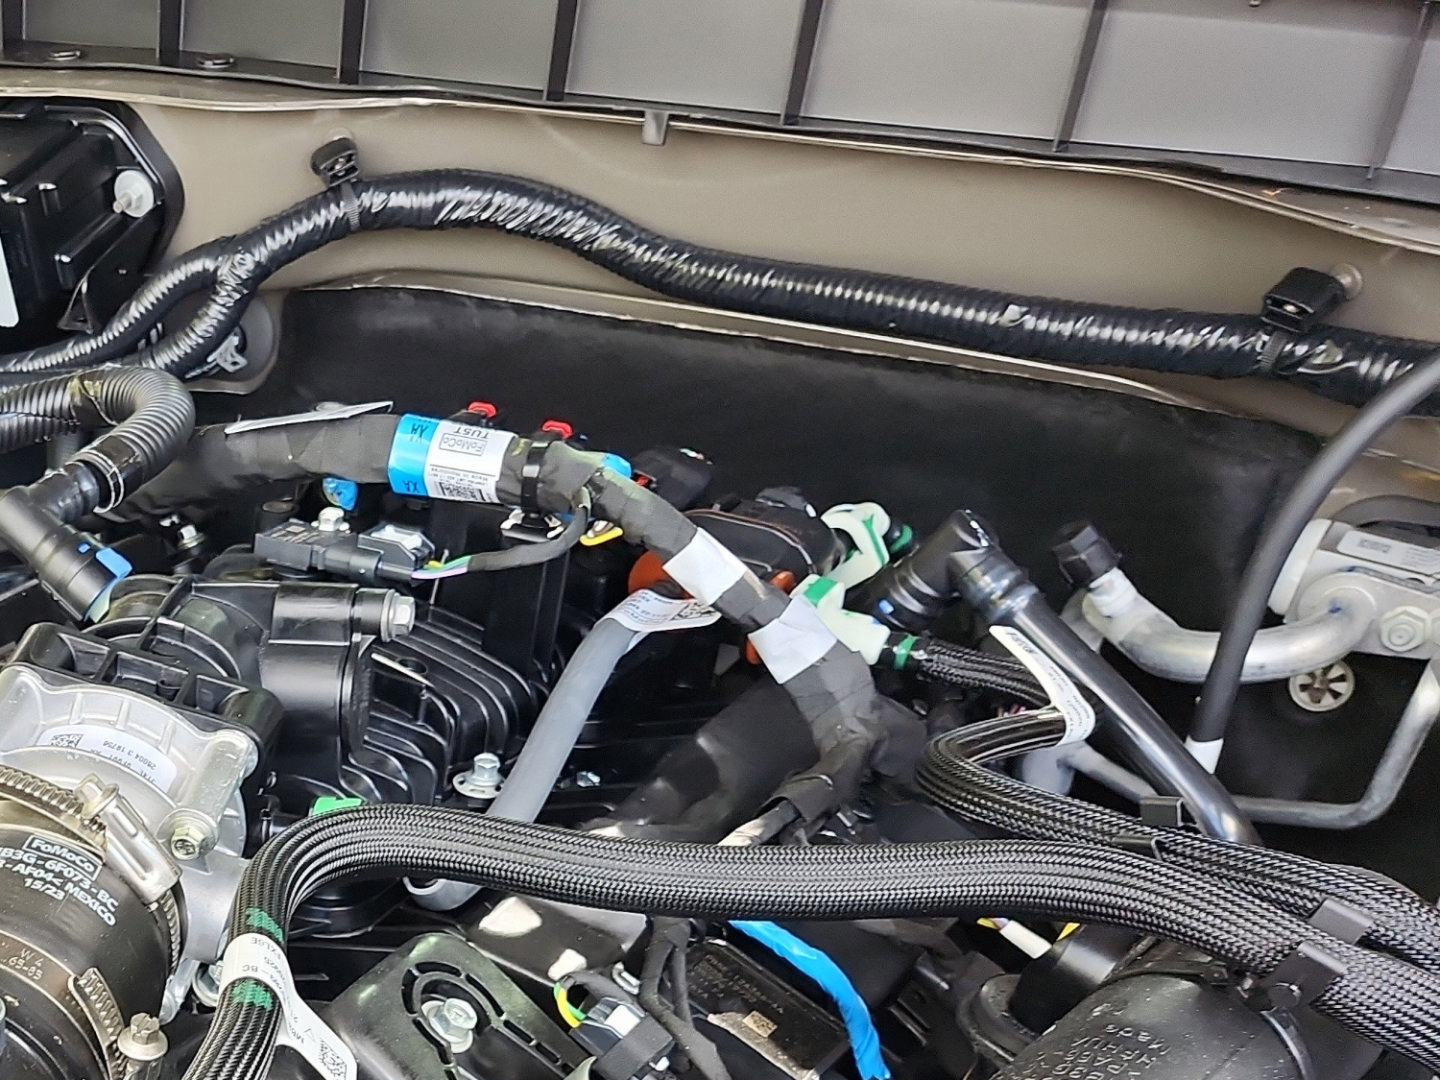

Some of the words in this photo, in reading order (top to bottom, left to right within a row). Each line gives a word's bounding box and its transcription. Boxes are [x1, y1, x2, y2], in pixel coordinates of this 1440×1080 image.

[442, 436, 486, 454] FoMoCo
[31, 838, 95, 873] FoMoCo
[24, 879, 66, 901] 15/23
[65, 882, 116, 927] MEXICO
